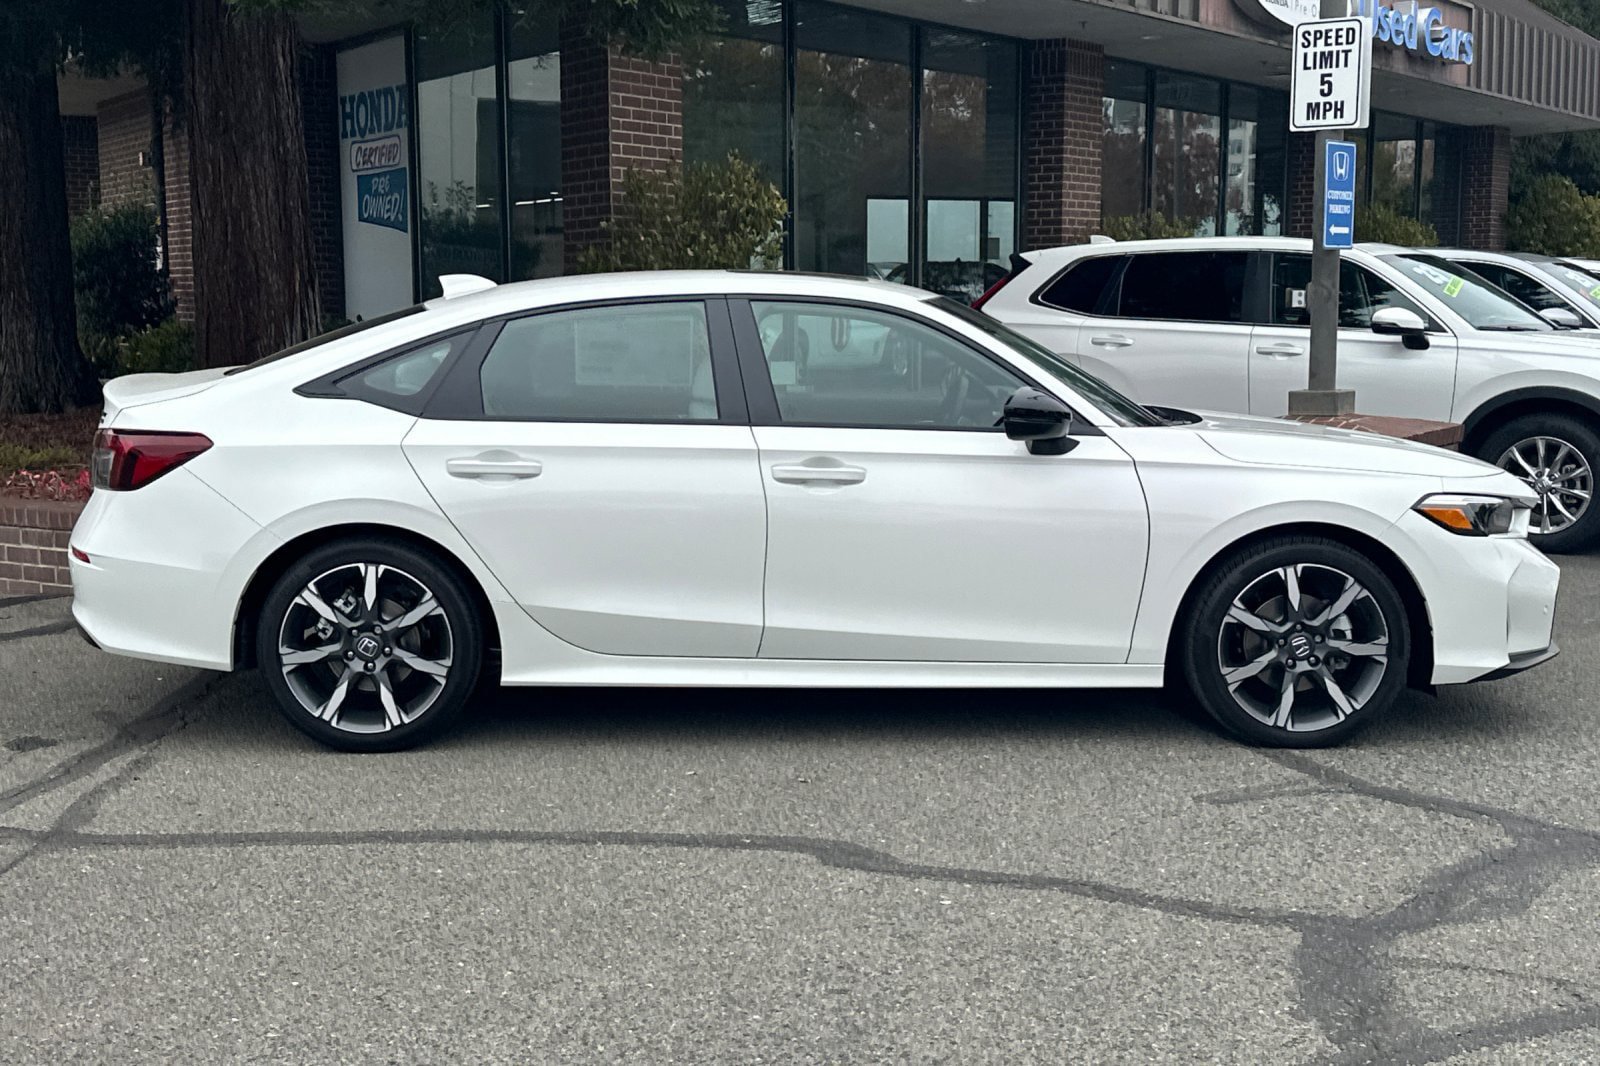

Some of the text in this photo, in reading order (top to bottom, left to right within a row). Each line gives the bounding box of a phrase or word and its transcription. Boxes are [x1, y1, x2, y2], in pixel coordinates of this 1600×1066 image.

[1301, 27, 1356, 49] SPEED
[1356, 0, 1473, 65] Used Cars
[1303, 49, 1352, 70] LIMIT
[1320, 73, 1333, 97] 5
[340, 85, 408, 138] HONDA
[1306, 100, 1344, 120] MPH
[355, 145, 398, 168] CERTIFIED
[371, 175, 390, 194] PRE
[362, 190, 403, 221] OWNED!
